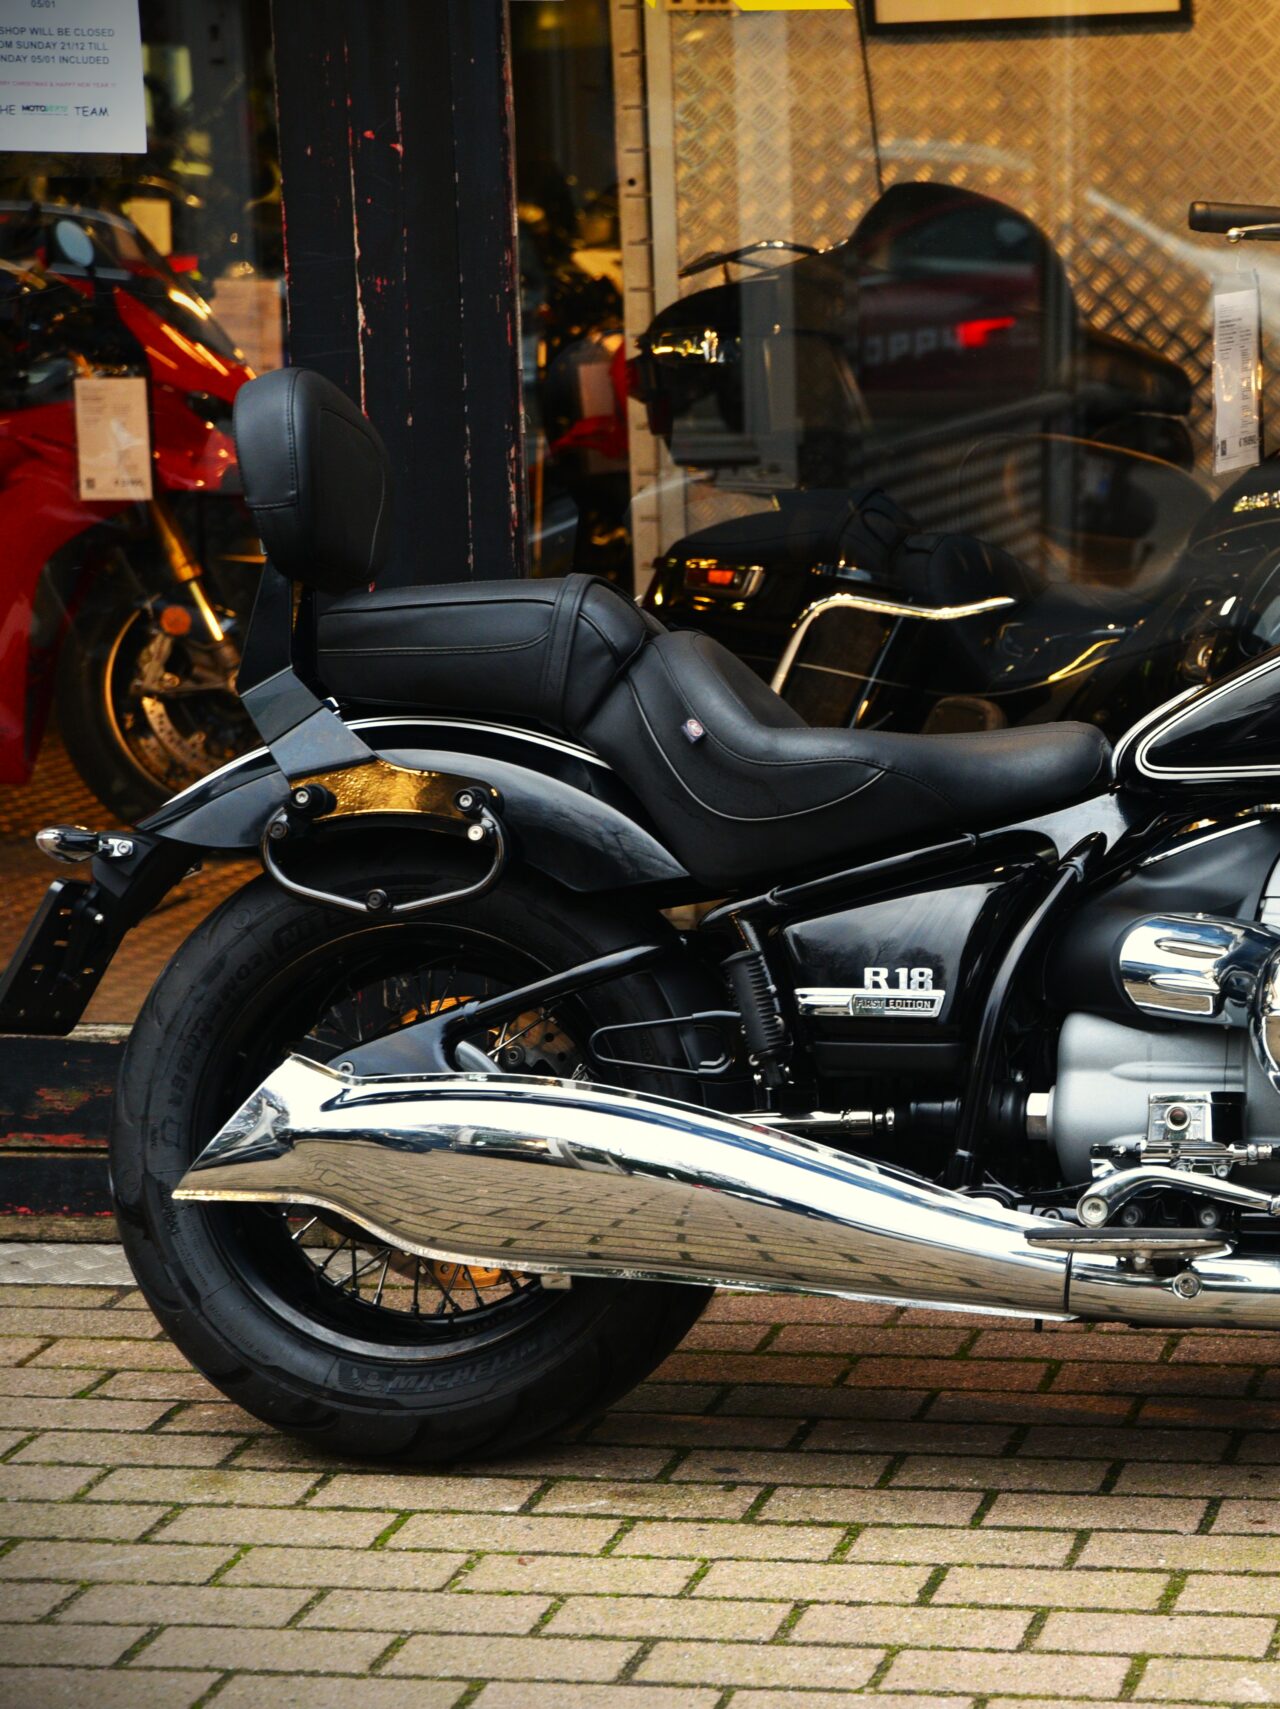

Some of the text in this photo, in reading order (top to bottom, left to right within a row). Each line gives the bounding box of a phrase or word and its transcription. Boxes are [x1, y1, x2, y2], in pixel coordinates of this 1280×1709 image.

[0, 26, 115, 37] SHOP WILL BE CLOSED
[15, 41, 57, 50] SUNDAY
[60, 42, 85, 50] 21/12
[88, 42, 109, 51] TILL
[30, 55, 55, 64] 05/01
[59, 56, 110, 65] INCLUDED
[74, 106, 109, 116] TEAM
[864, 967, 934, 991] R 18
[855, 999, 931, 1009] FIRST EDITION
[387, 1338, 539, 1393] MICHELIN
